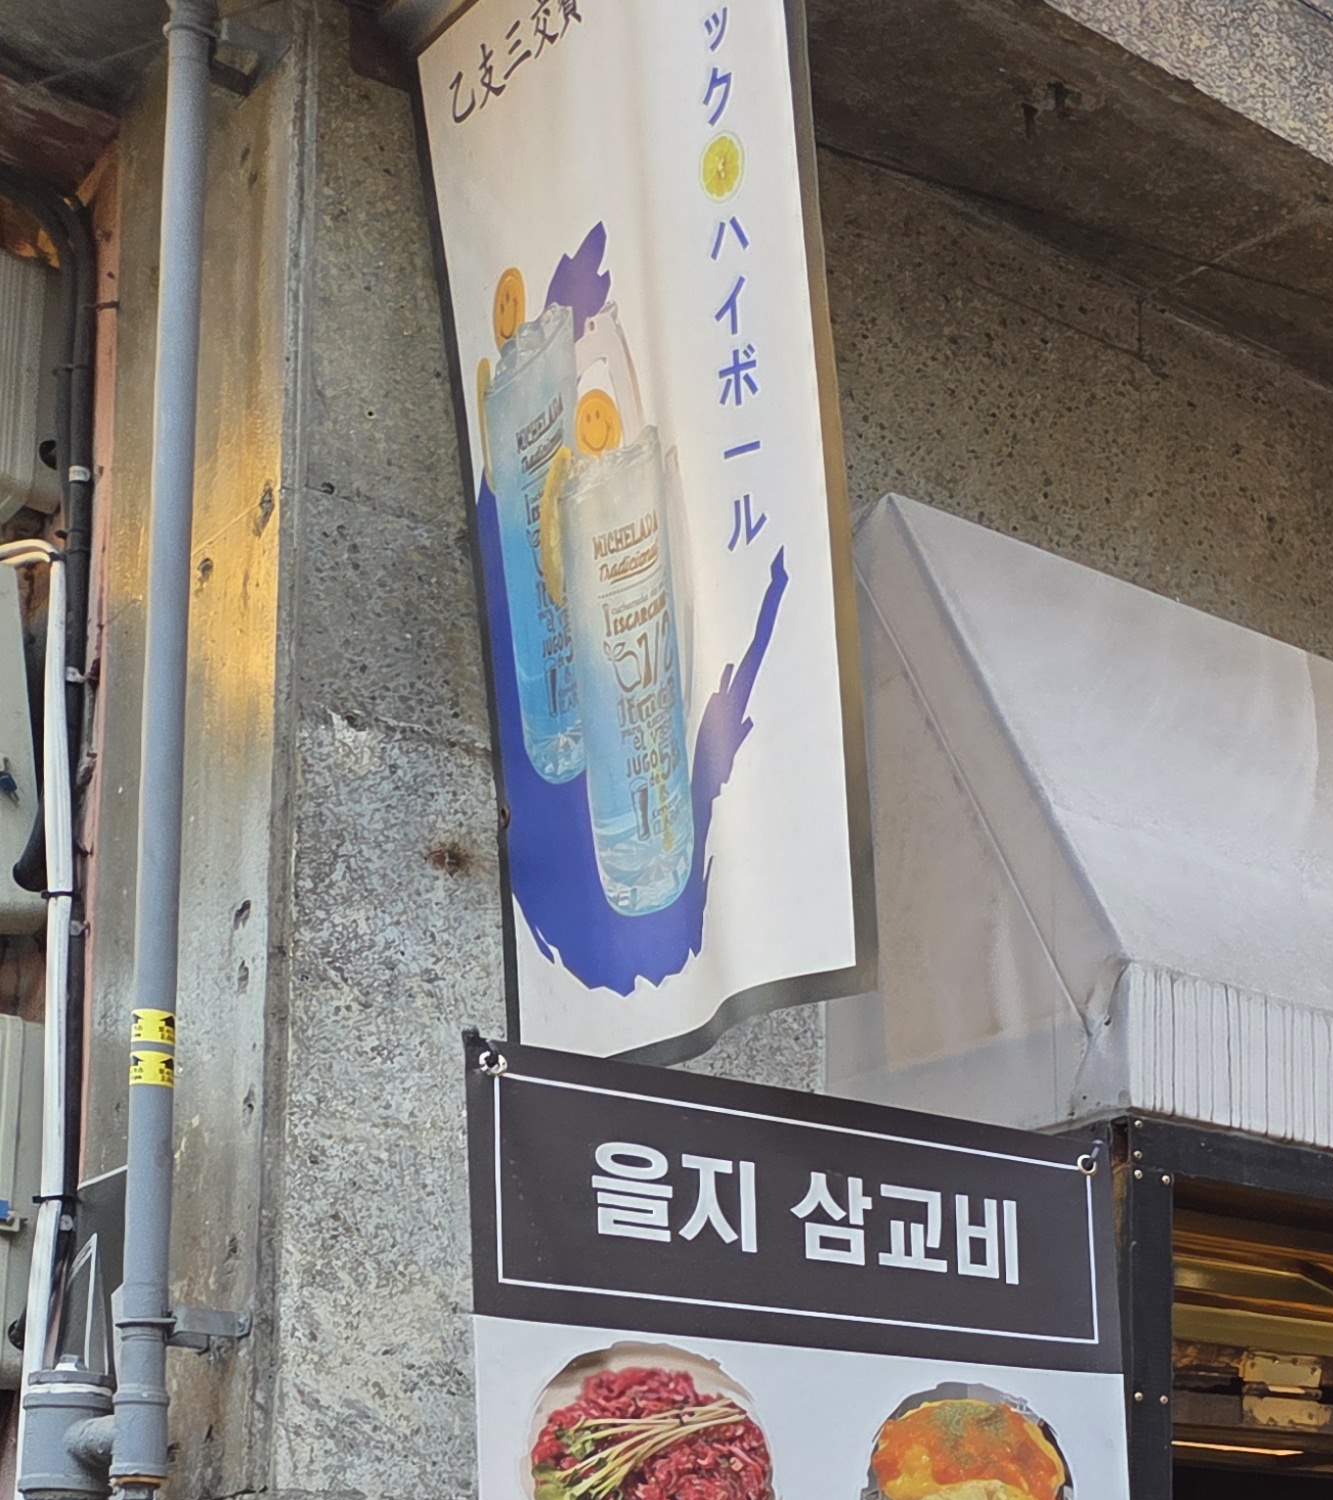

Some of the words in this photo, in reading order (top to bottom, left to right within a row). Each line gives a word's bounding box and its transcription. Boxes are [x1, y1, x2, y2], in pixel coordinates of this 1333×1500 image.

[711, 216, 767, 551] ハイボール
[591, 1141, 758, 1254] 을지
[790, 1171, 1020, 1286] 삼교비
